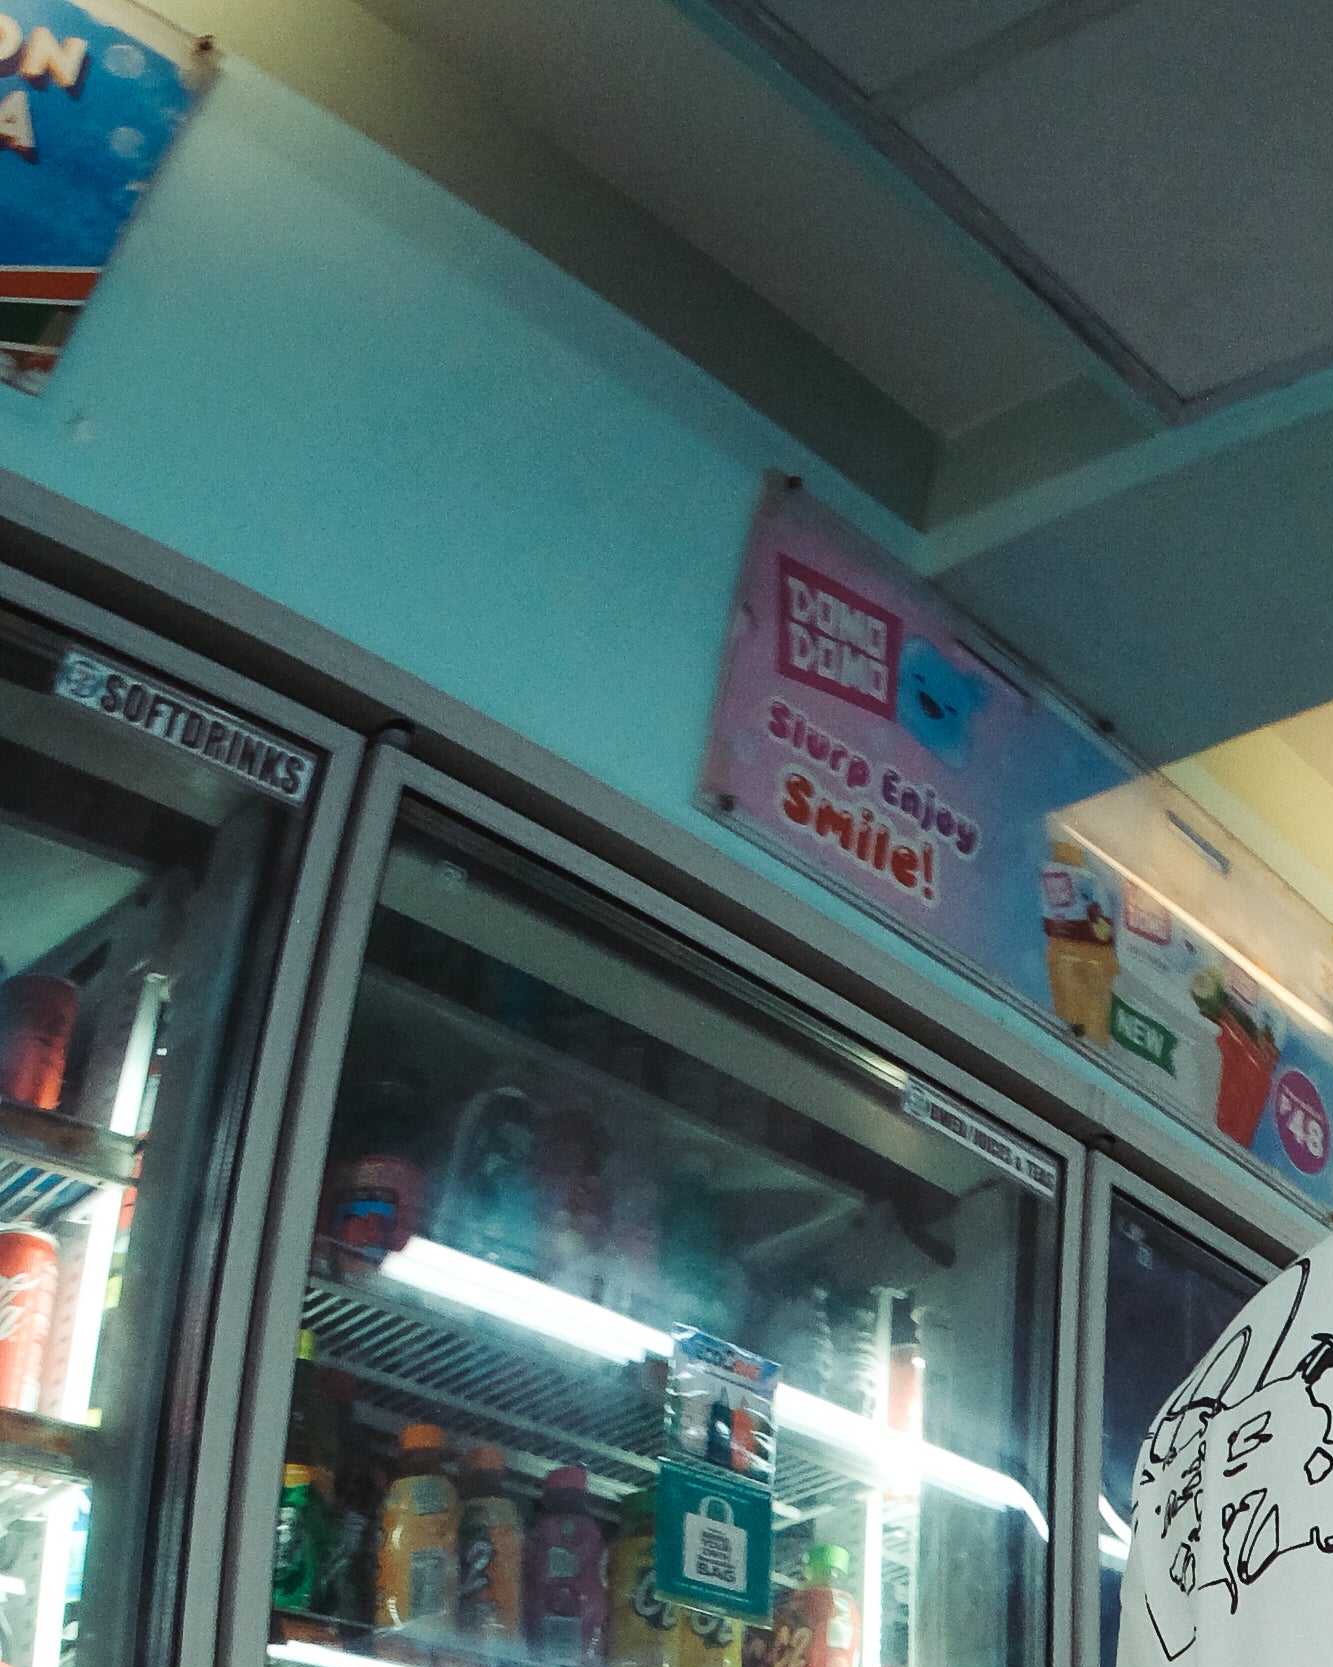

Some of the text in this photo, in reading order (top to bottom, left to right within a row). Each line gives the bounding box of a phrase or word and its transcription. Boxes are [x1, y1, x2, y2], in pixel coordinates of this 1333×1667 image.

[787, 576, 888, 660] DOMO
[789, 621, 889, 702] DOMO
[99, 675, 304, 796] SOFTDRINKS
[768, 700, 977, 855] Slurp Enjoy
[782, 772, 935, 901] Smile!
[1117, 1008, 1165, 1059] NEW
